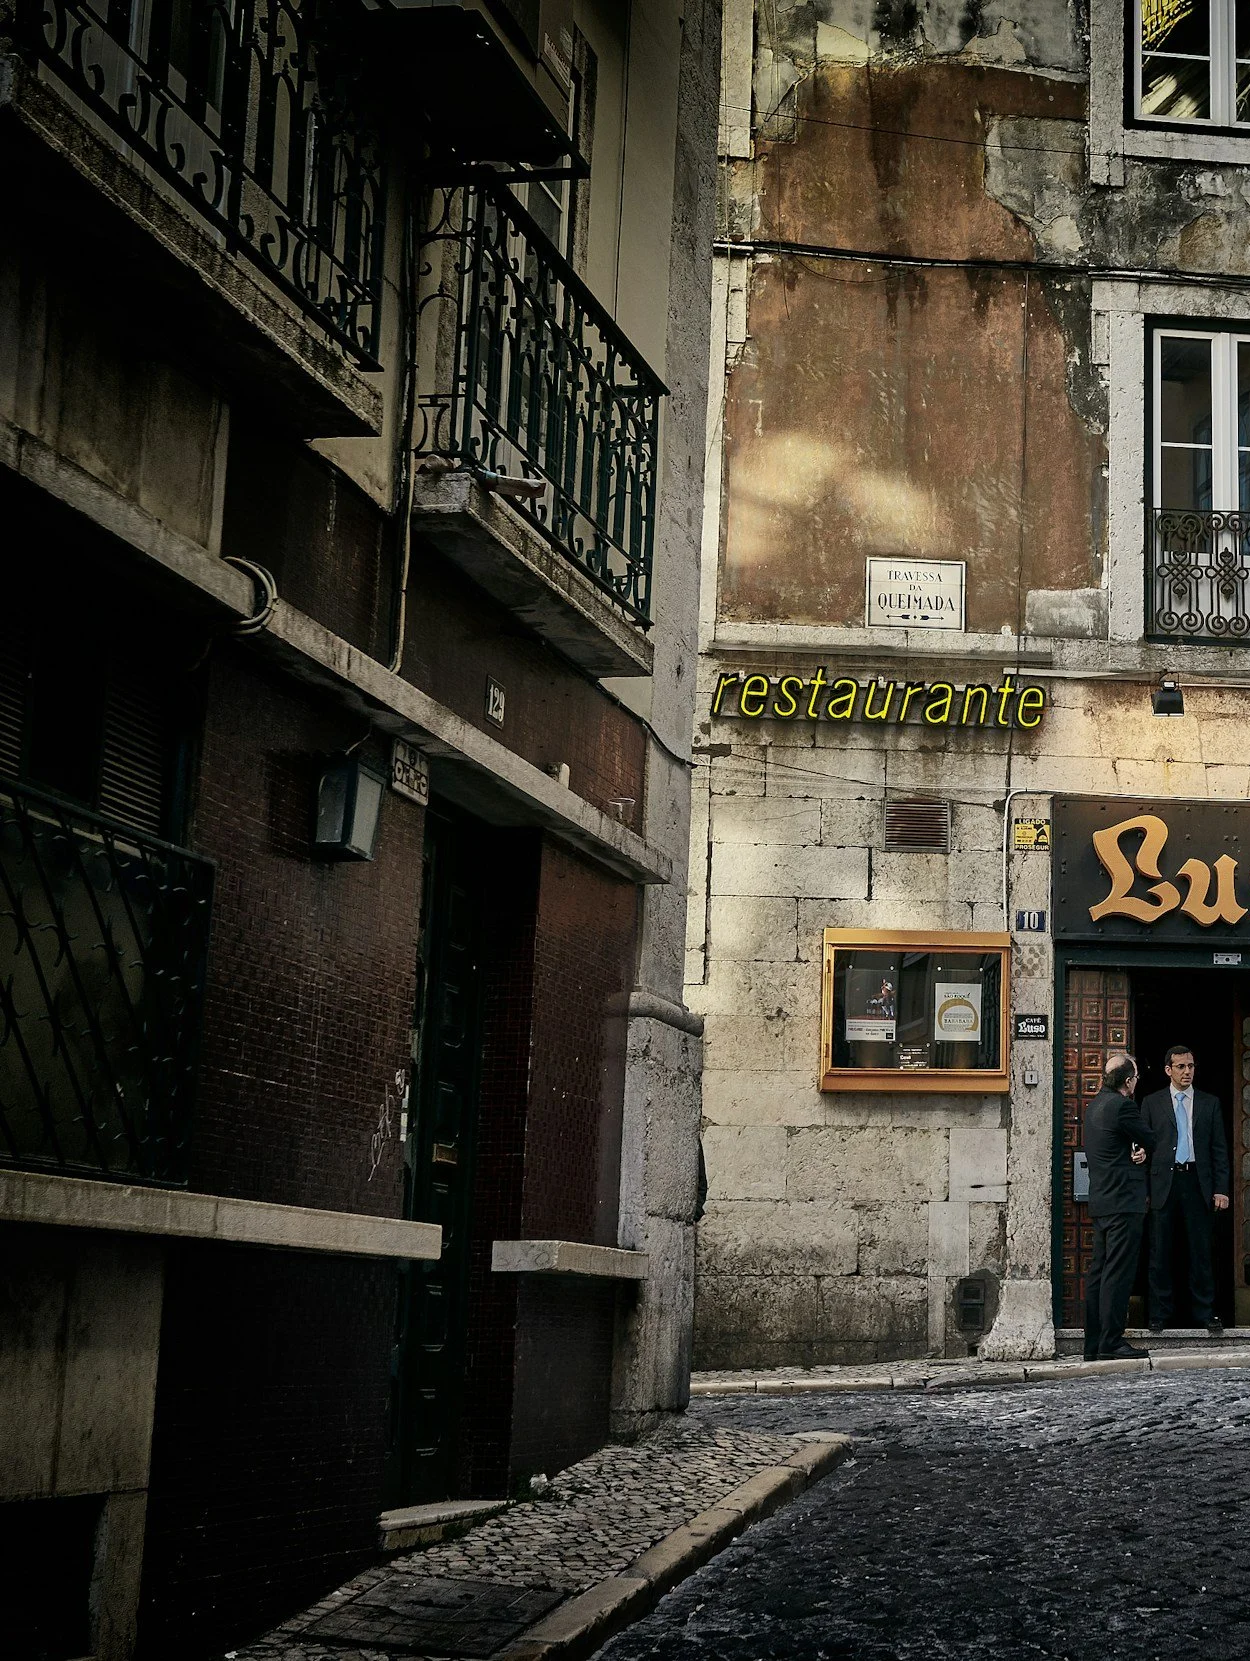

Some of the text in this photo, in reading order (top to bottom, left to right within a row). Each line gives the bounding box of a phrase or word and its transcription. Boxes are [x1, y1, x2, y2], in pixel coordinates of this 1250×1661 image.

[887, 569, 943, 582] TRAVESSA
[909, 583, 923, 591] DA
[877, 592, 955, 611] QUEIMADA
[488, 684, 505, 722] 129
[711, 667, 1045, 728] restaurante
[1022, 911, 1039, 930] 10
[1017, 1021, 1046, 1034] Luso
